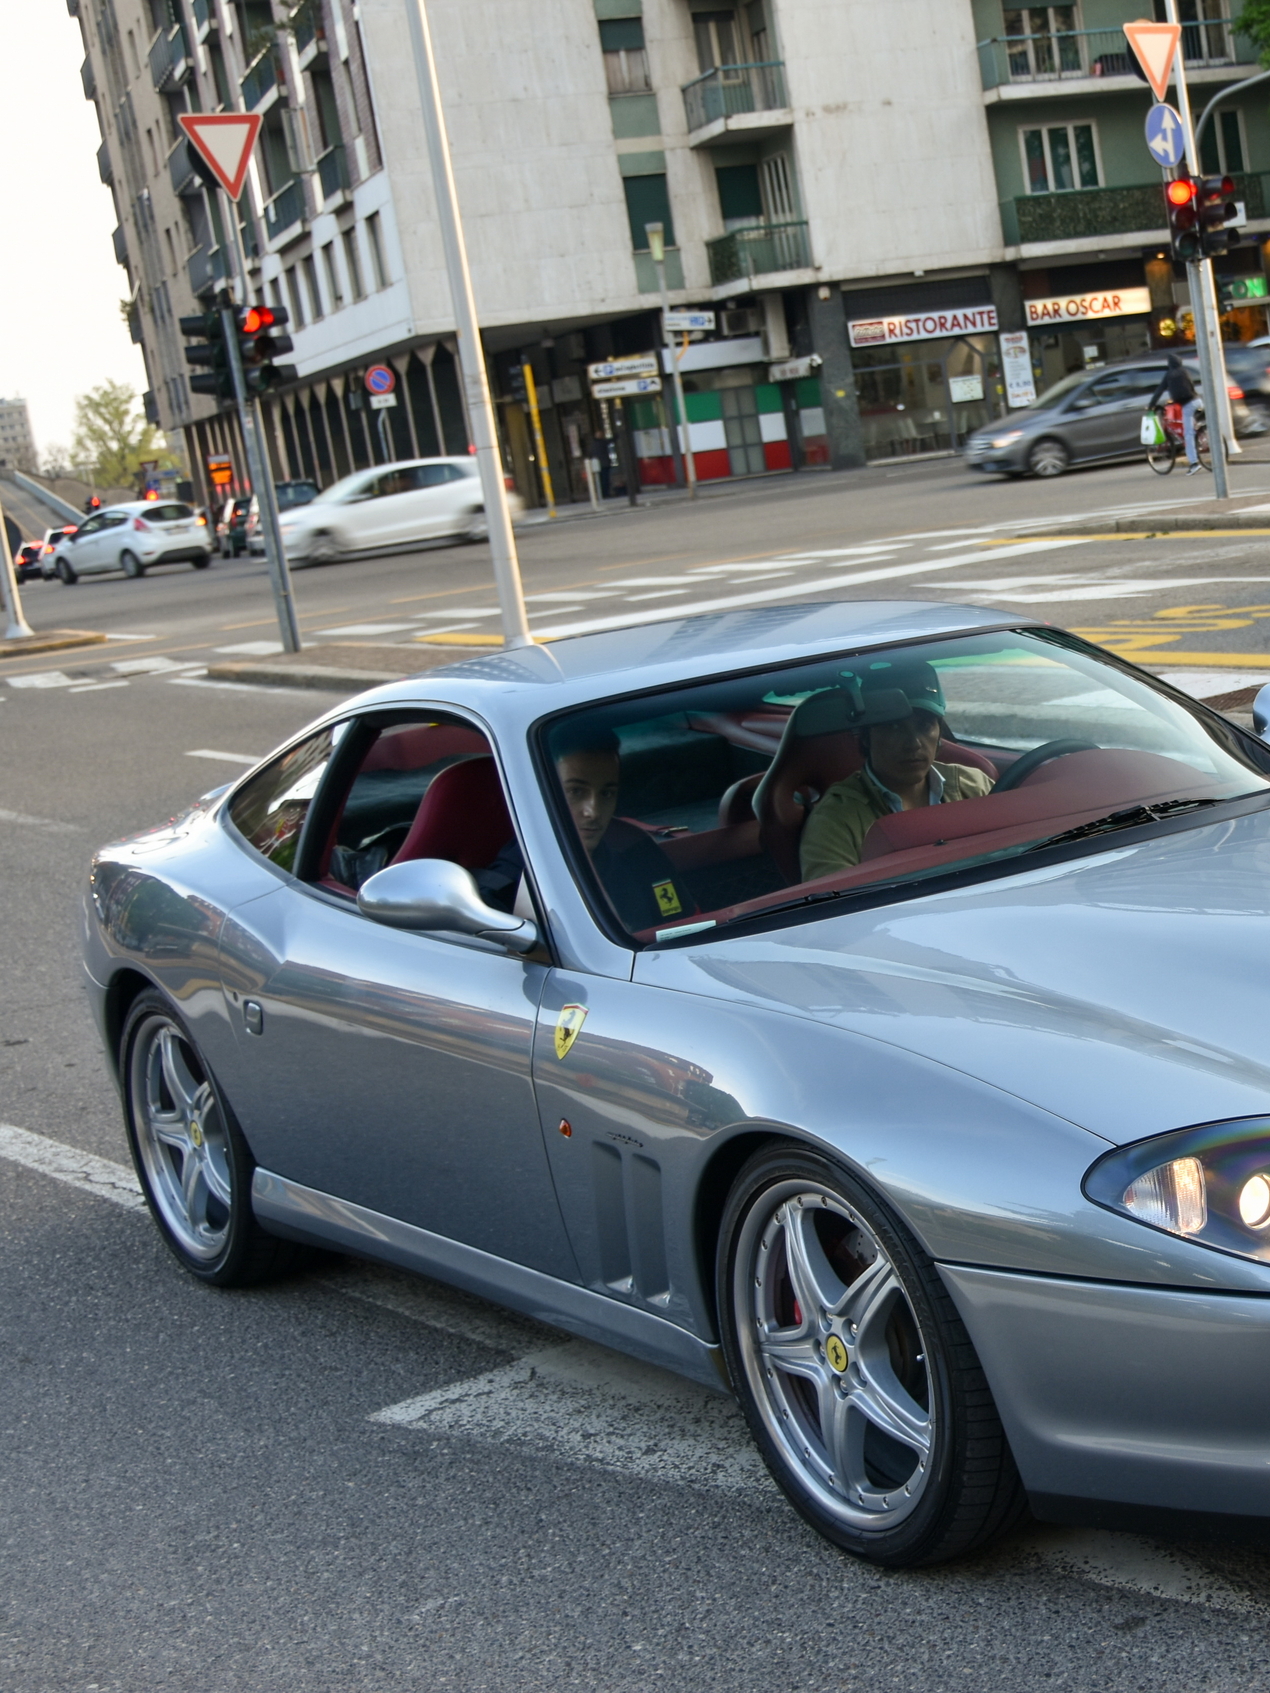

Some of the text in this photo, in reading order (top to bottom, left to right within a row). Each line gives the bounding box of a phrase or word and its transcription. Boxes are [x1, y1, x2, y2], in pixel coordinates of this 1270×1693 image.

[1028, 294, 1123, 322] BAR OSCAR
[886, 309, 997, 339] RISTORANTE
